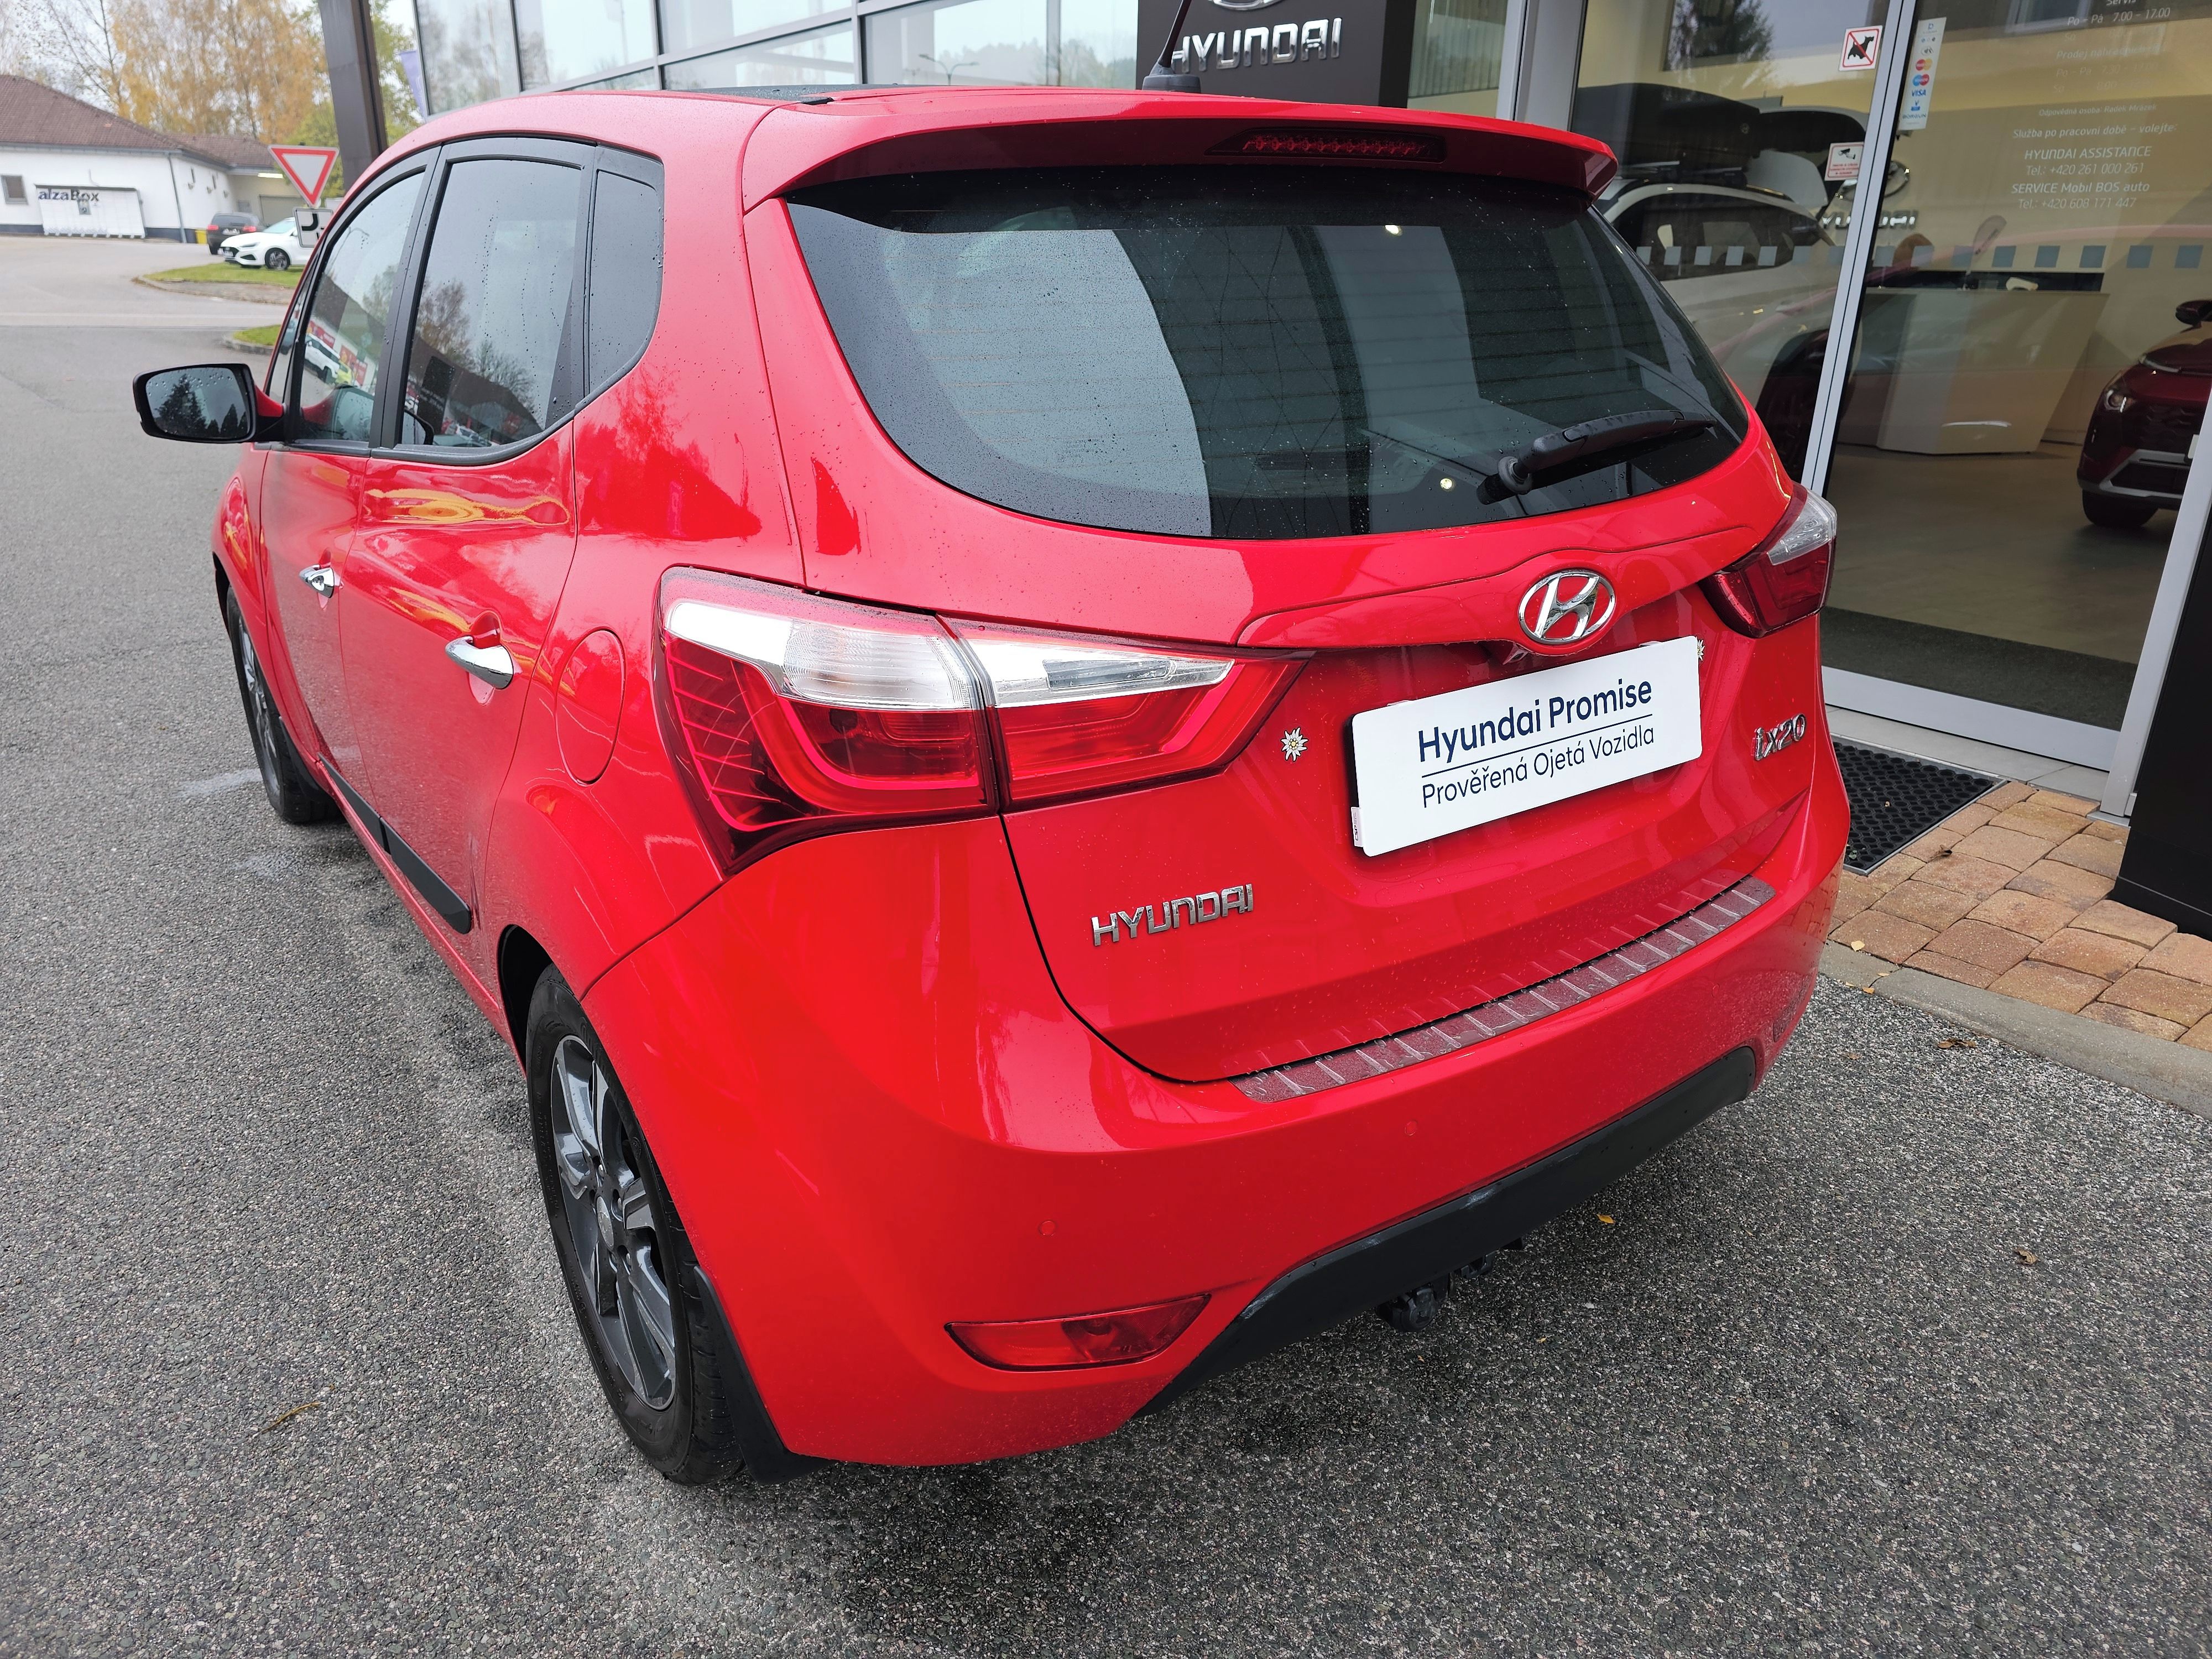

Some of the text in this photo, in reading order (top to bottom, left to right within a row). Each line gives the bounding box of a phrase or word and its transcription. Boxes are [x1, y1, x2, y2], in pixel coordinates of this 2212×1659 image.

[2067, 17, 2080, 26] Po
[2091, 13, 2104, 23] Pá
[2112, 11, 2133, 22] 7.00
[2145, 7, 2171, 19] 17.00
[1171, 17, 1342, 73] HYUNDAI
[2056, 49, 2088, 59] Prodej
[2104, 105, 2127, 113] Radek
[2013, 128, 2042, 138] Služba
[2045, 130, 2057, 139] po
[2059, 126, 2100, 138] pracovní
[2103, 125, 2126, 135] době
[2024, 145, 2152, 160] HYUNDAI ASSISTANCE
[2026, 162, 2144, 176] Tel.: +420 261 000 261
[38, 188, 99, 201] alzaBox
[2011, 181, 2150, 194] SERVICE Mobil BOS auto
[2019, 197, 2137, 210] Tel.: +420 608 171 447
[1418, 678, 1652, 763] Hyundai Promise
[1754, 713, 1807, 761] ix20
[1422, 724, 1655, 809] Prověřená Ojetá Vozidla
[1091, 884, 1254, 947] HYUNDAI
